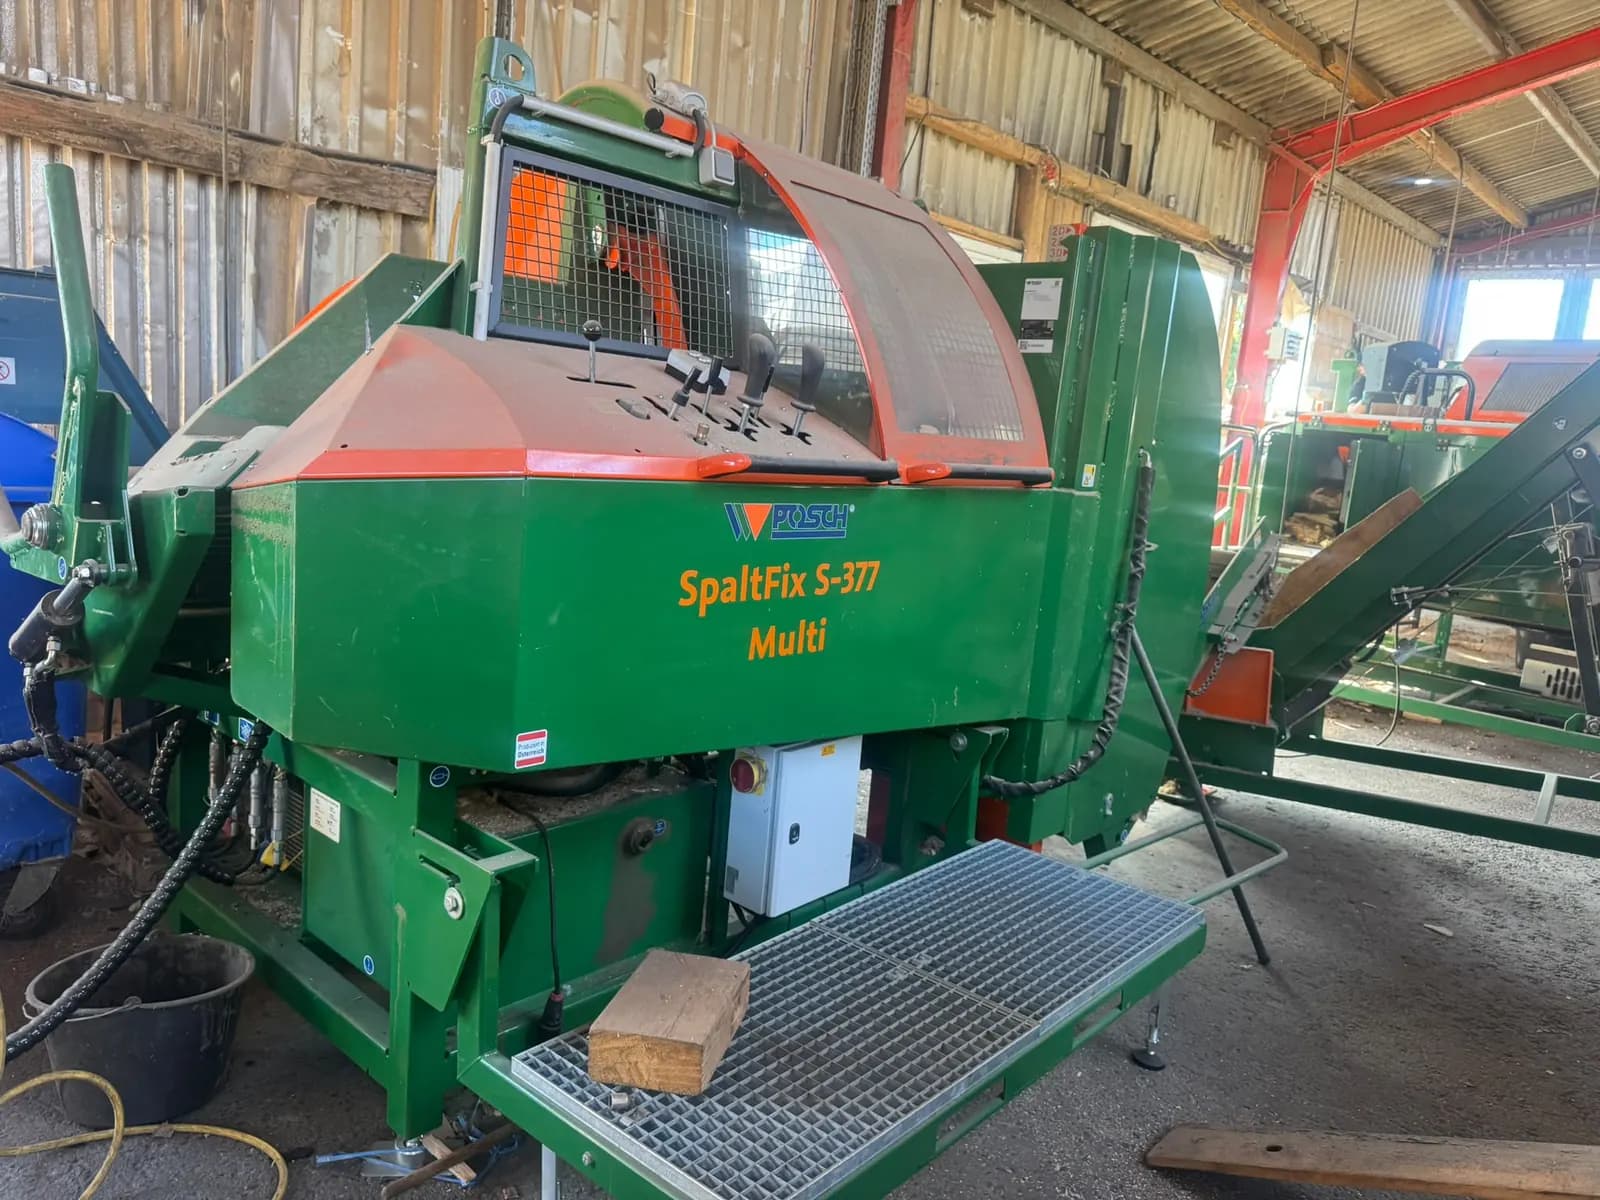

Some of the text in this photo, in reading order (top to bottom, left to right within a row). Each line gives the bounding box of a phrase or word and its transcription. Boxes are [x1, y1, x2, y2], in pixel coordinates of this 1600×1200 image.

[771, 503, 849, 529] POSCH
[678, 560, 880, 617] SpaltFix S-377
[748, 617, 827, 661] Multi
